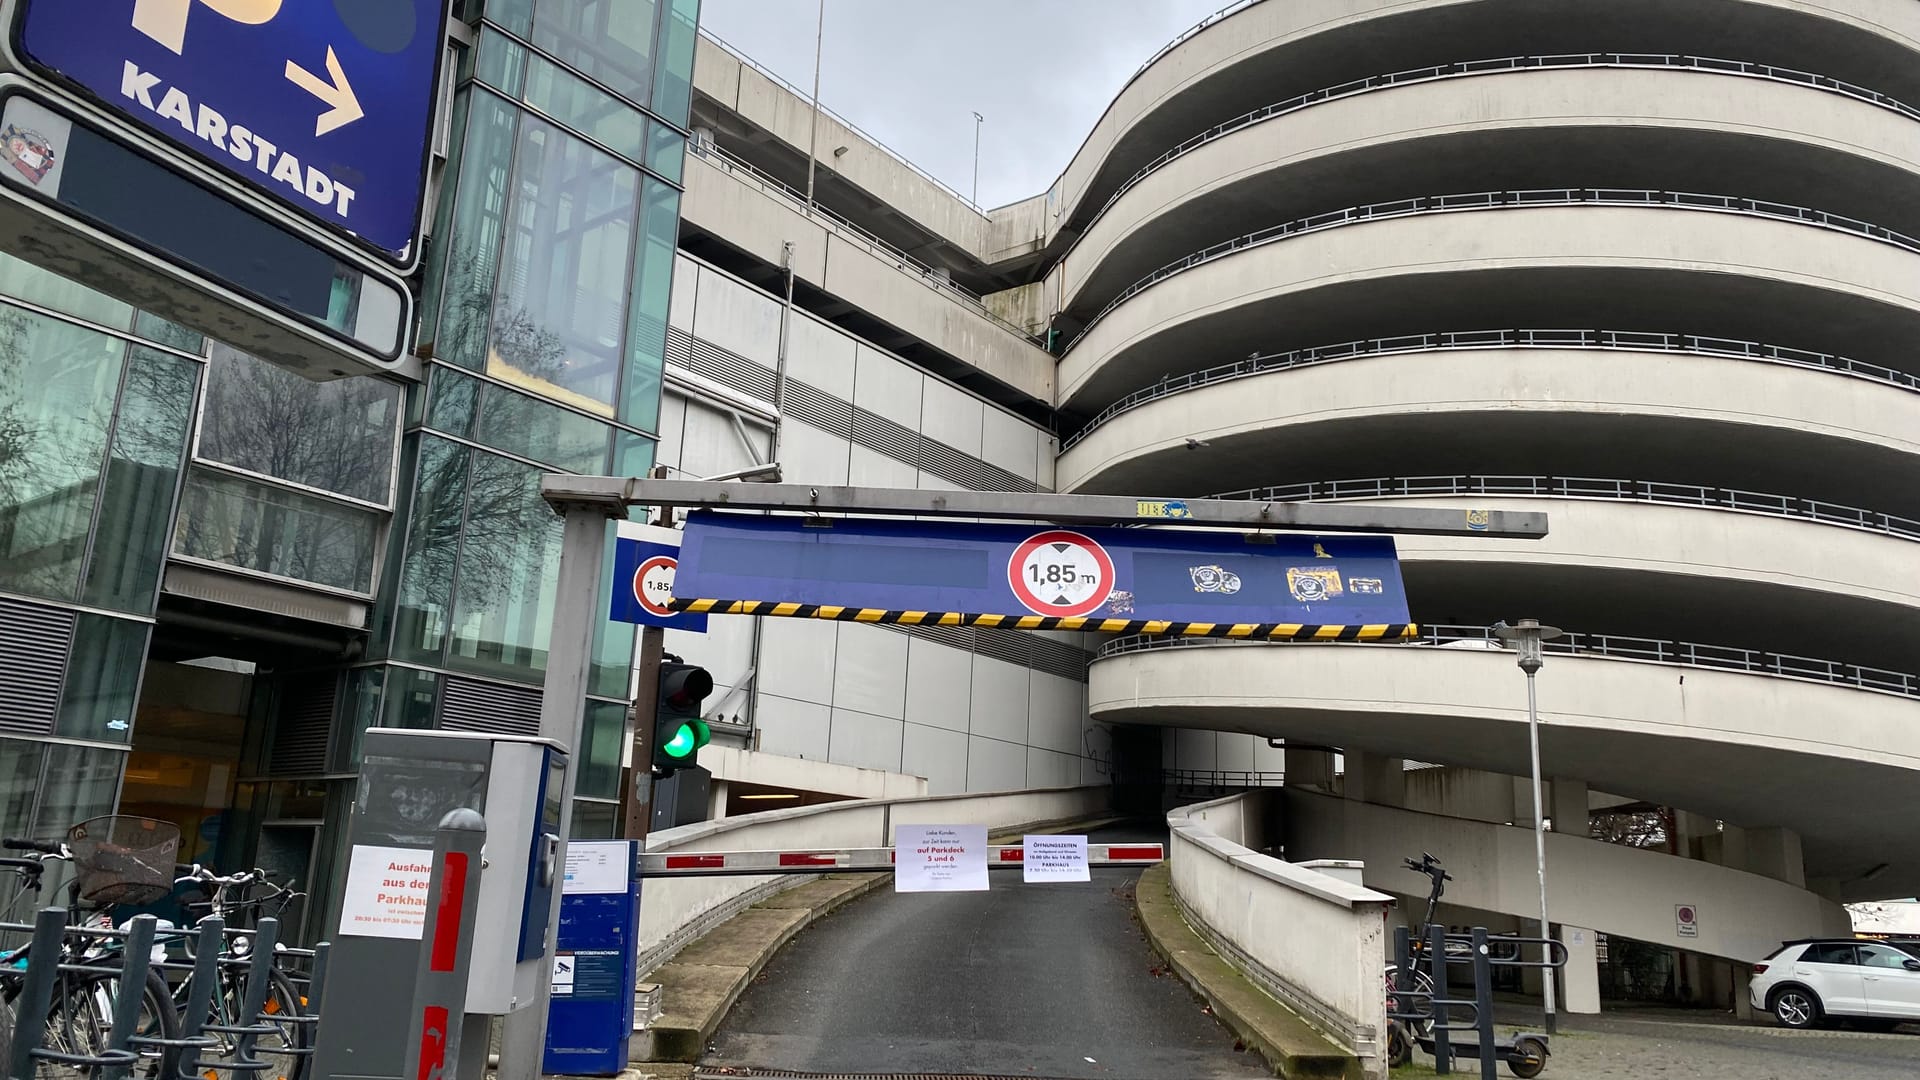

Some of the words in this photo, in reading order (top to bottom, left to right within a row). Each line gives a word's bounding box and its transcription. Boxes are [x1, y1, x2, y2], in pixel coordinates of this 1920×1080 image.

[121, 59, 355, 218] KARSTADT
[1029, 563, 1076, 586] 1,85
[1081, 574, 1096, 585] m
[917, 846, 929, 854] auf
[931, 846, 965, 854] Parkdeck
[388, 862, 432, 873] Ausfahr
[383, 879, 405, 888] aus
[377, 893, 427, 907] Parkhau
